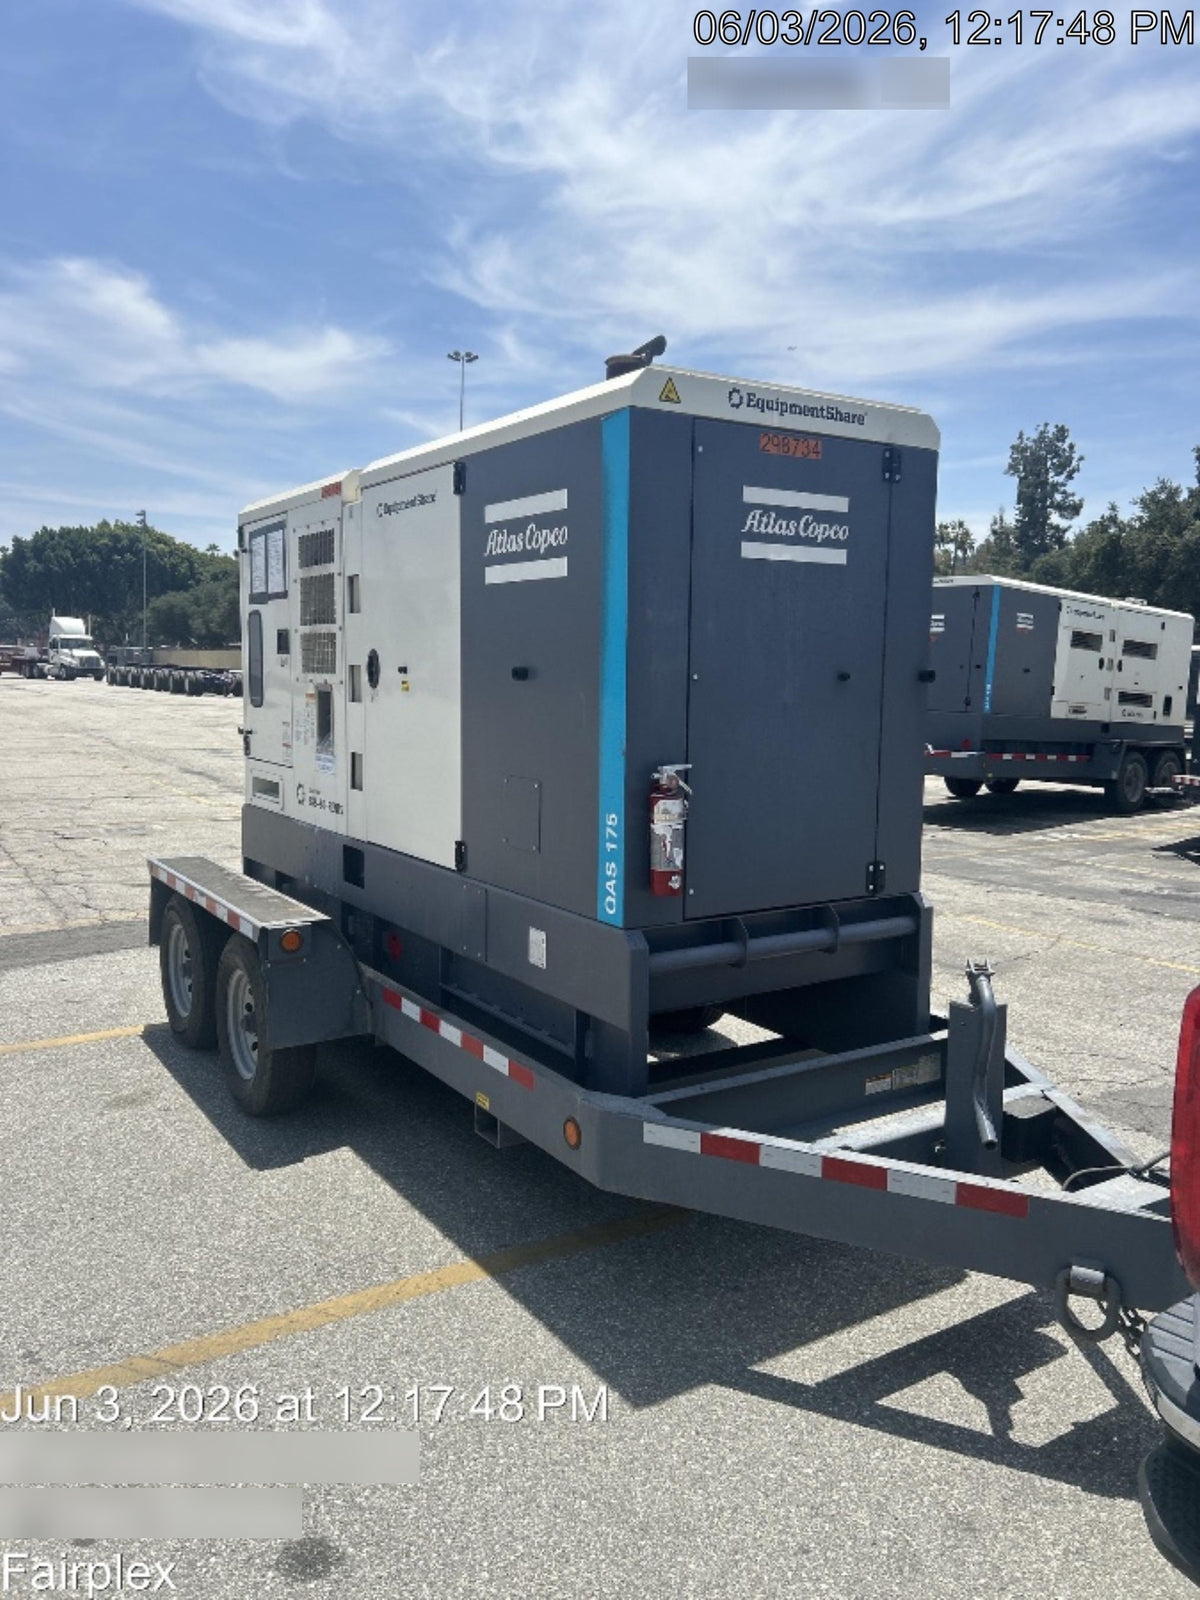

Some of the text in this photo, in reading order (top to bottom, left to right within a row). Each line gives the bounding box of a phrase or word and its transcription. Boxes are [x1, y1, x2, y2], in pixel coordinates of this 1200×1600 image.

[746, 392, 865, 426] EquipmentShare
[484, 523, 568, 557] Atlas Copco
[741, 510, 849, 543] Atlas Copco
[604, 813, 618, 915] QAS 175
